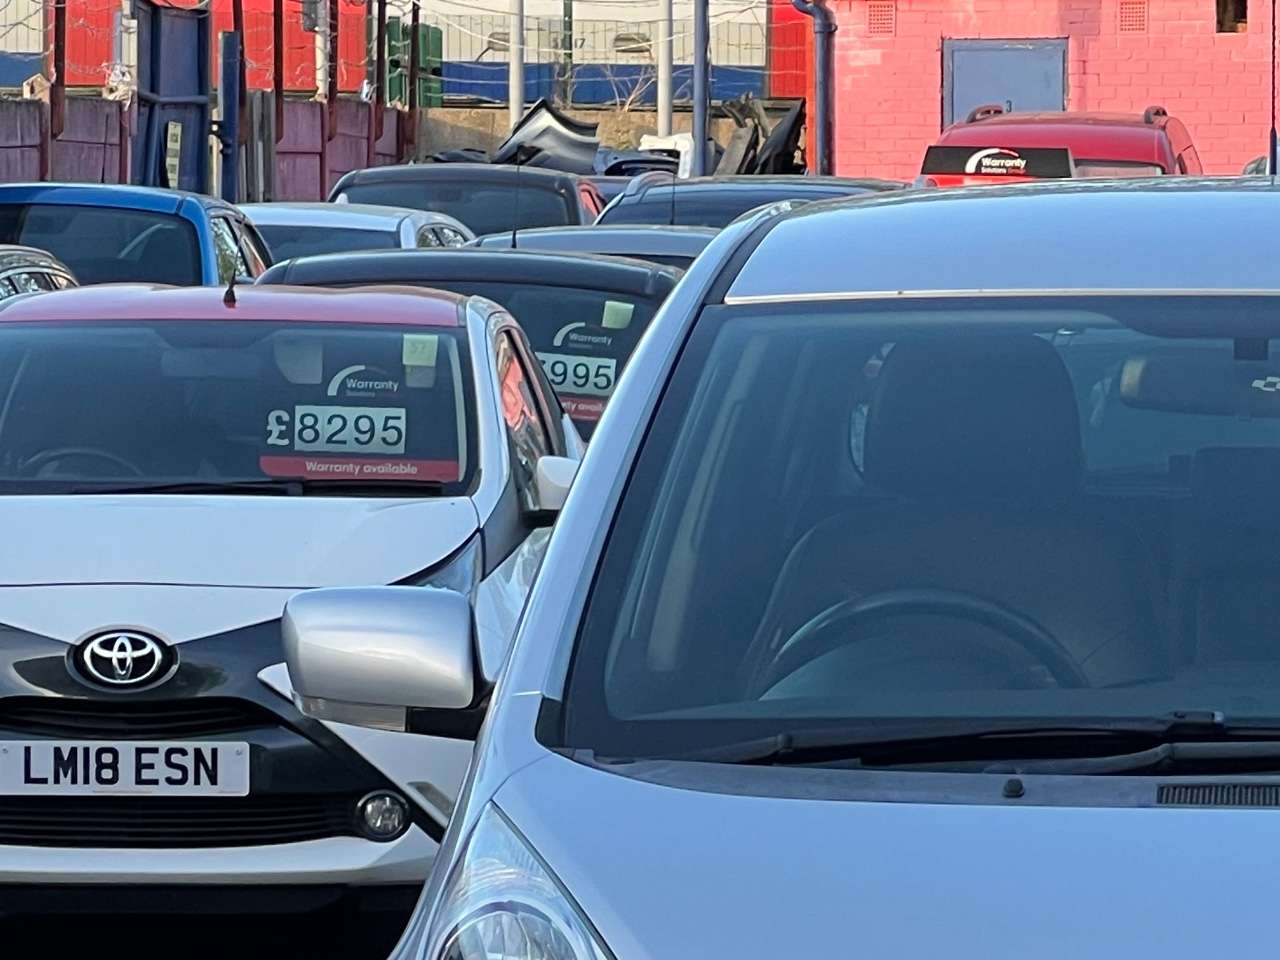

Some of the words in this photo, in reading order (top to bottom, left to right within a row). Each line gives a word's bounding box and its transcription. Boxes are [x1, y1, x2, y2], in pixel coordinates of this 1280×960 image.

[1006, 99, 1012, 113] 3
[981, 157, 1026, 169] Warranty
[541, 360, 612, 390] 995
[346, 378, 399, 392] Warranty
[266, 410, 403, 447] £8295
[305, 460, 360, 475] Warranty
[363, 462, 418, 474] available
[24, 746, 119, 785] LM18
[135, 747, 218, 786] ESN
